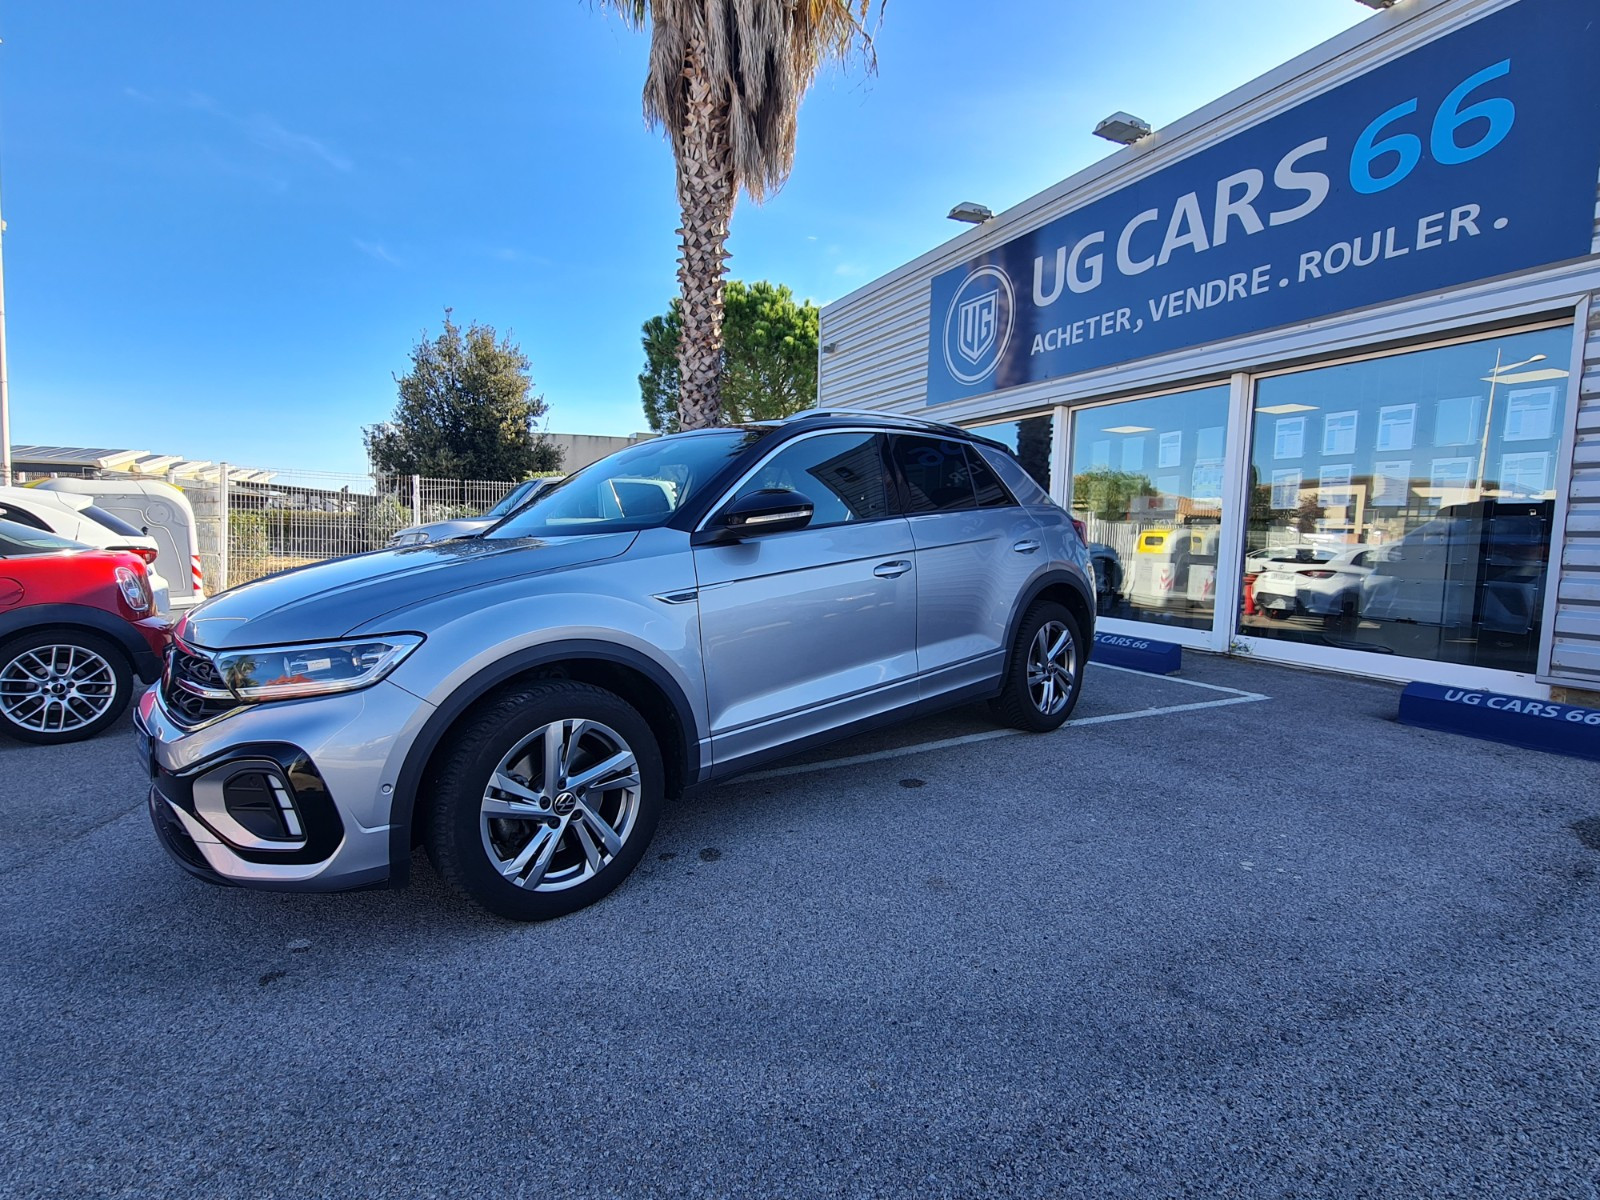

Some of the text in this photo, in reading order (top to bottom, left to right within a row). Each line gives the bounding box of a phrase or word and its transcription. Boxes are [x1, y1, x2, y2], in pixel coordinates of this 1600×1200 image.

[1032, 58, 1517, 307] UG CARS 66
[1030, 307, 1143, 356] ACHETER,
[1100, 635, 1134, 647] CARS
[1132, 640, 1150, 649] 66
[1444, 689, 1600, 725] UG CARS 66
